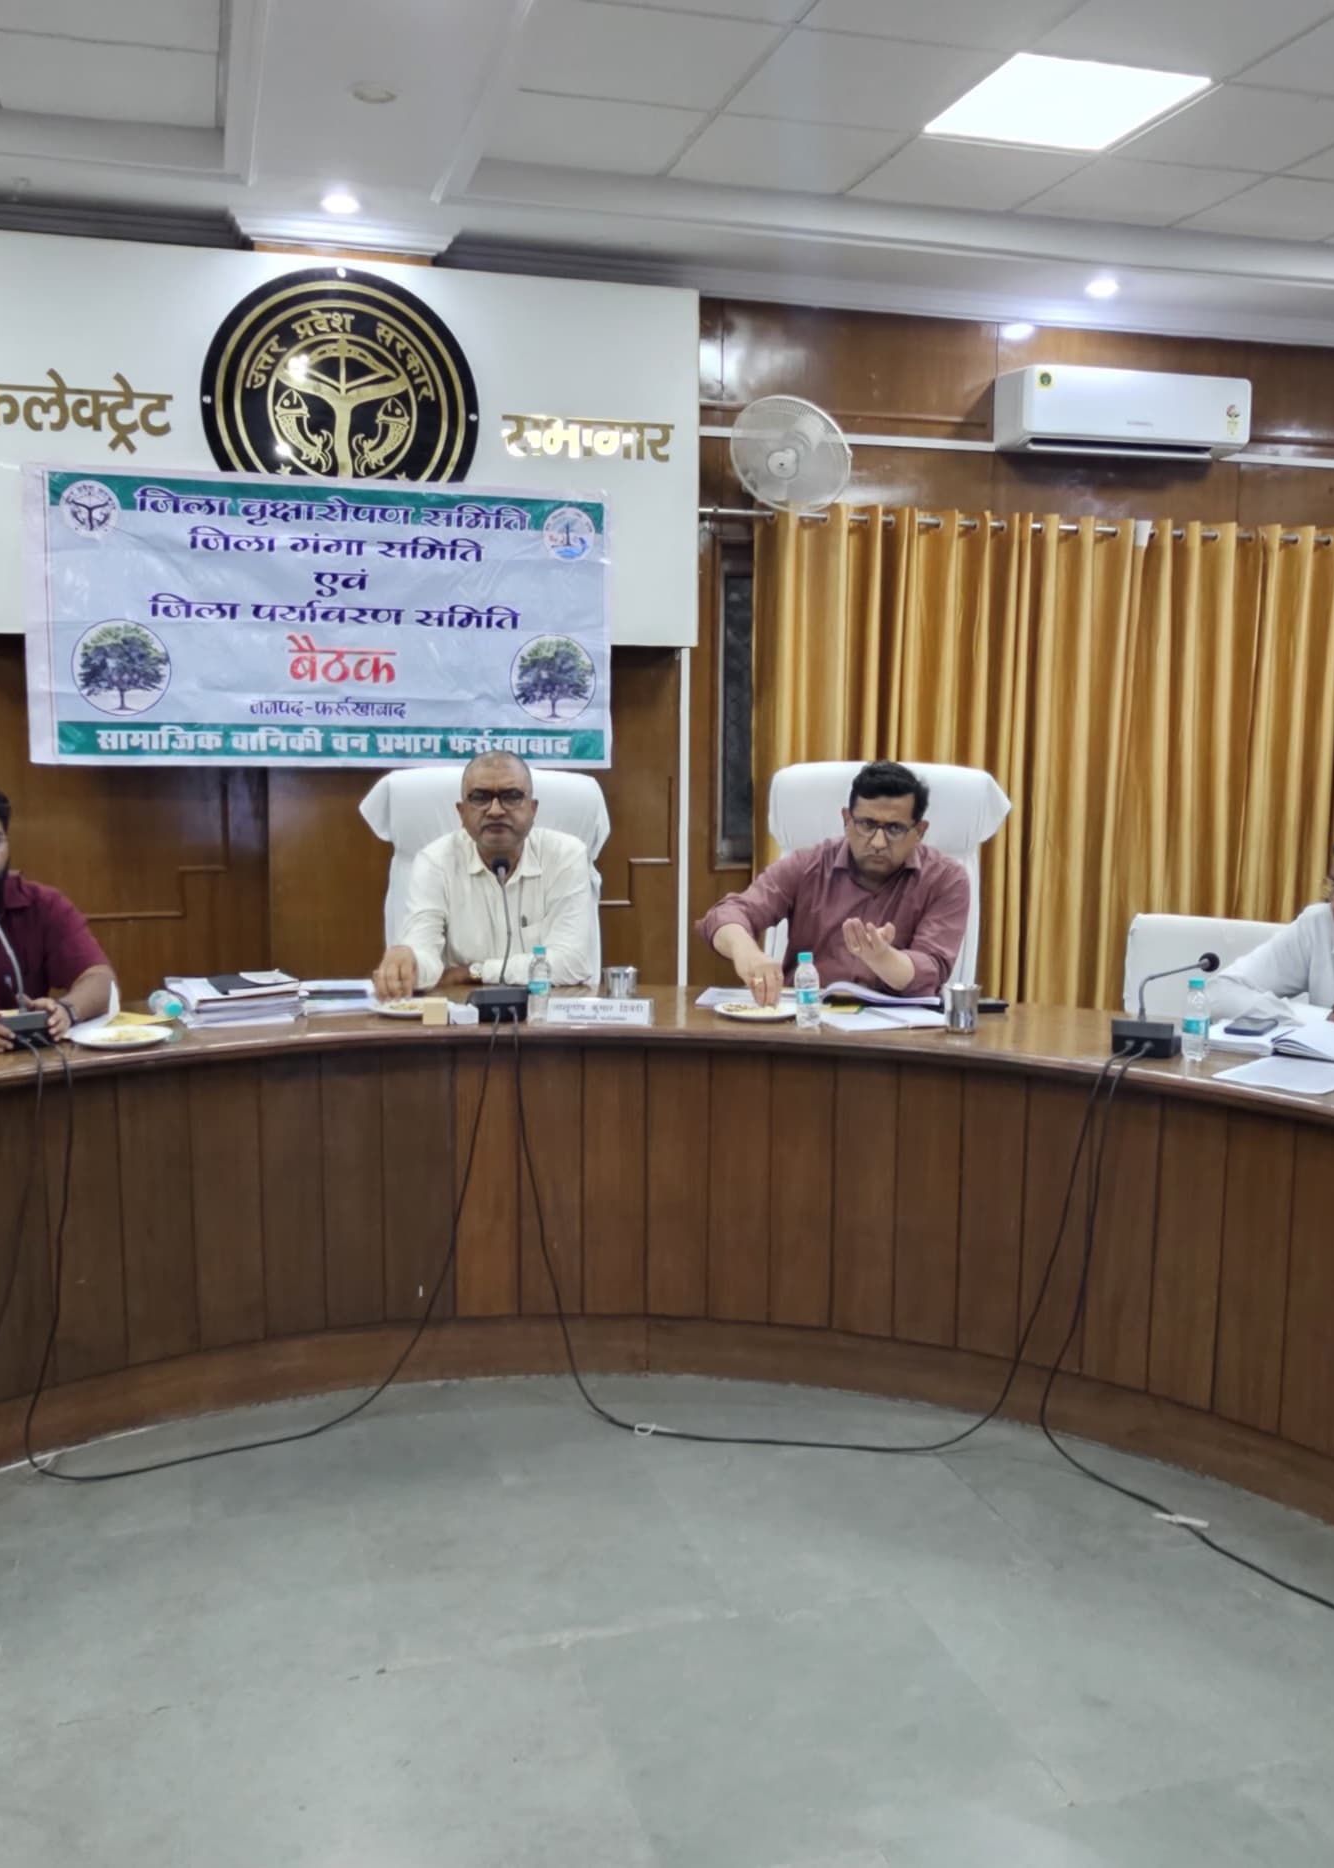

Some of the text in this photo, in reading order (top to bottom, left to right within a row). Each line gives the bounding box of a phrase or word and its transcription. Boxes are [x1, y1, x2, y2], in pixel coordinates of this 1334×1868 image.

[245, 333, 287, 389] उत्तर
[375, 321, 436, 402] सरकार
[134, 485, 228, 517] जिला
[238, 495, 413, 527] वृक्षारोपण
[421, 503, 529, 532] समिति
[188, 526, 484, 563] जिला गंगा समिति
[313, 568, 369, 598] एवं
[149, 592, 521, 630] जिला पर्यावरण समिति
[287, 633, 397, 684] बैठक
[96, 725, 223, 750] सामाजिक
[231, 726, 324, 752] वानिकी
[332, 734, 370, 753] वन
[376, 734, 443, 754] प्रभाग
